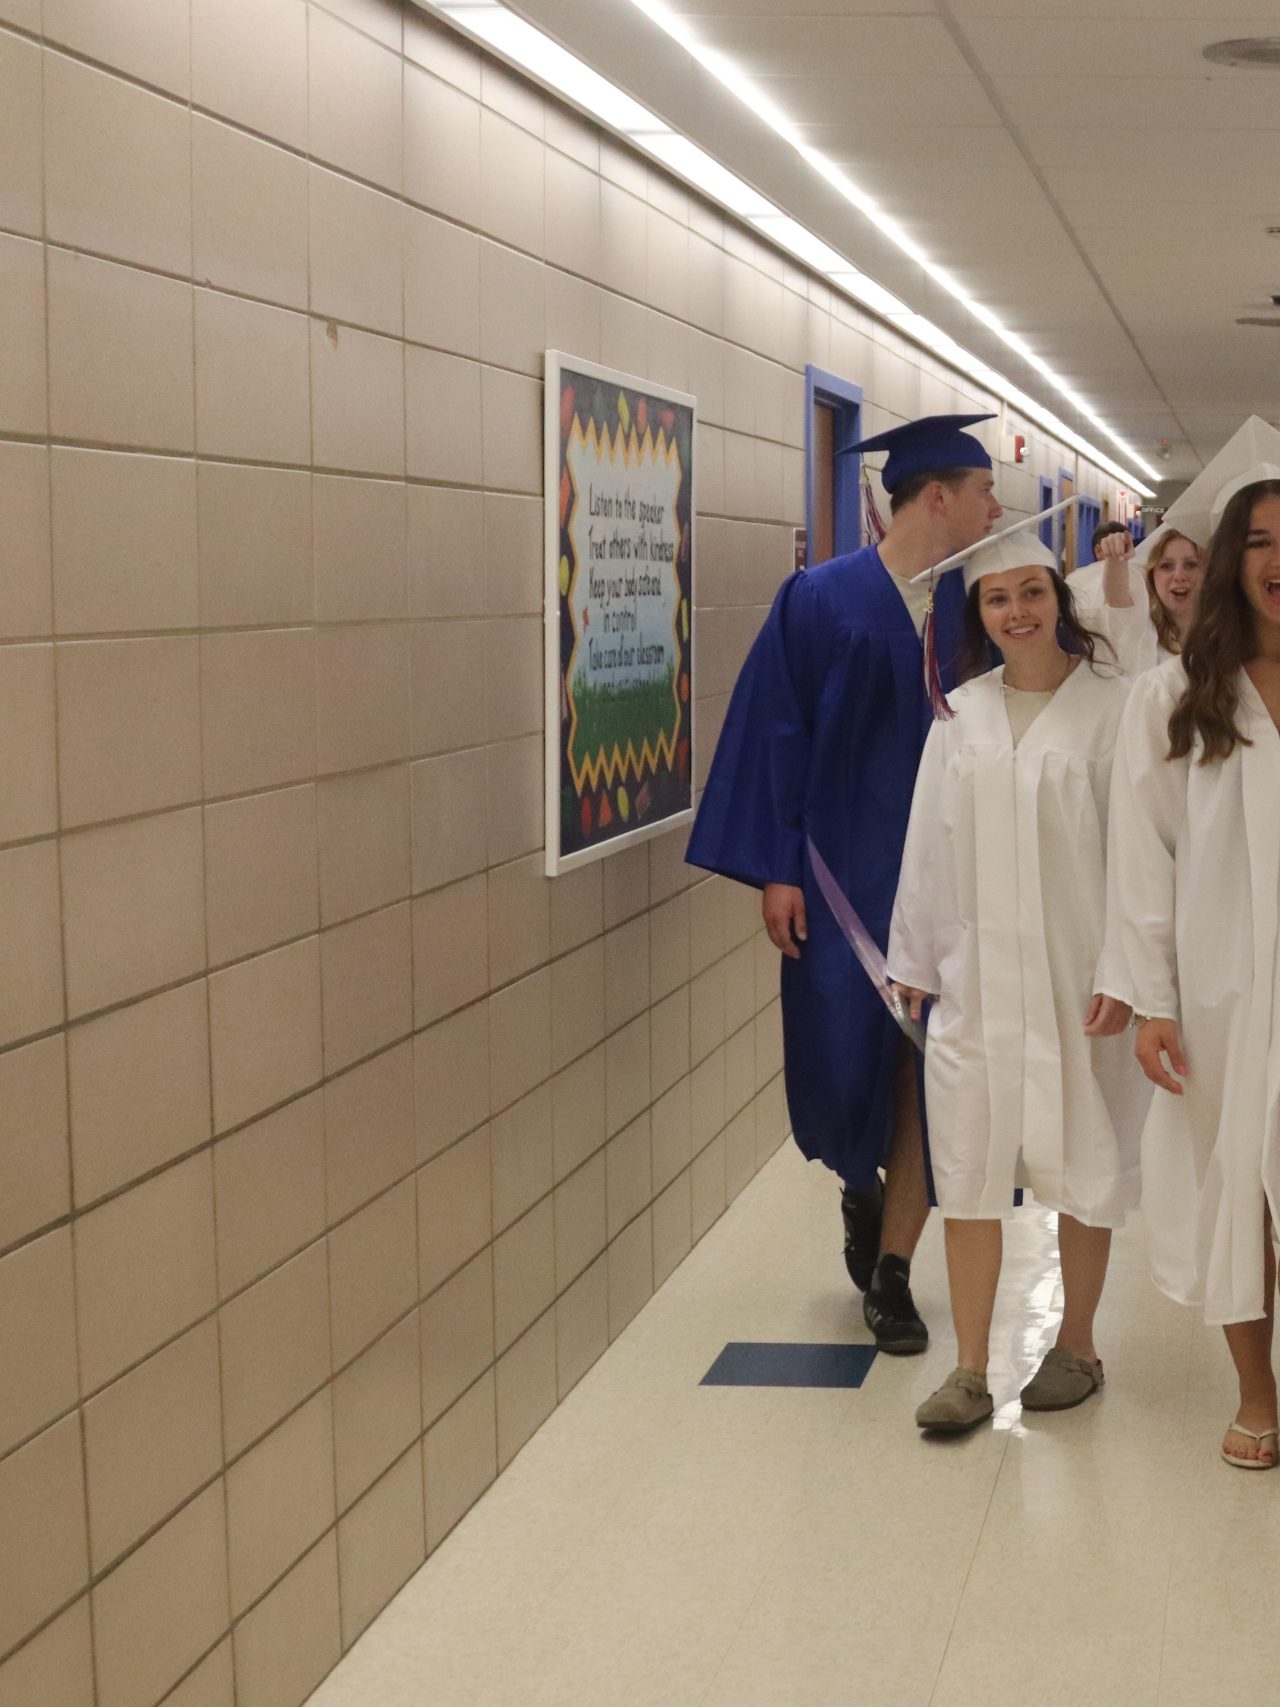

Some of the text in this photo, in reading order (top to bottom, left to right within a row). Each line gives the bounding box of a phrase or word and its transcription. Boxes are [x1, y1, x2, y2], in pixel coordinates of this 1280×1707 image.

[589, 482, 665, 529] Listen to the speaker
[588, 524, 674, 563] Treat others with kindness
[589, 565, 661, 609] Keep your body safe and
[603, 603, 637, 633] in control
[588, 632, 664, 671] Take care of our classroom
